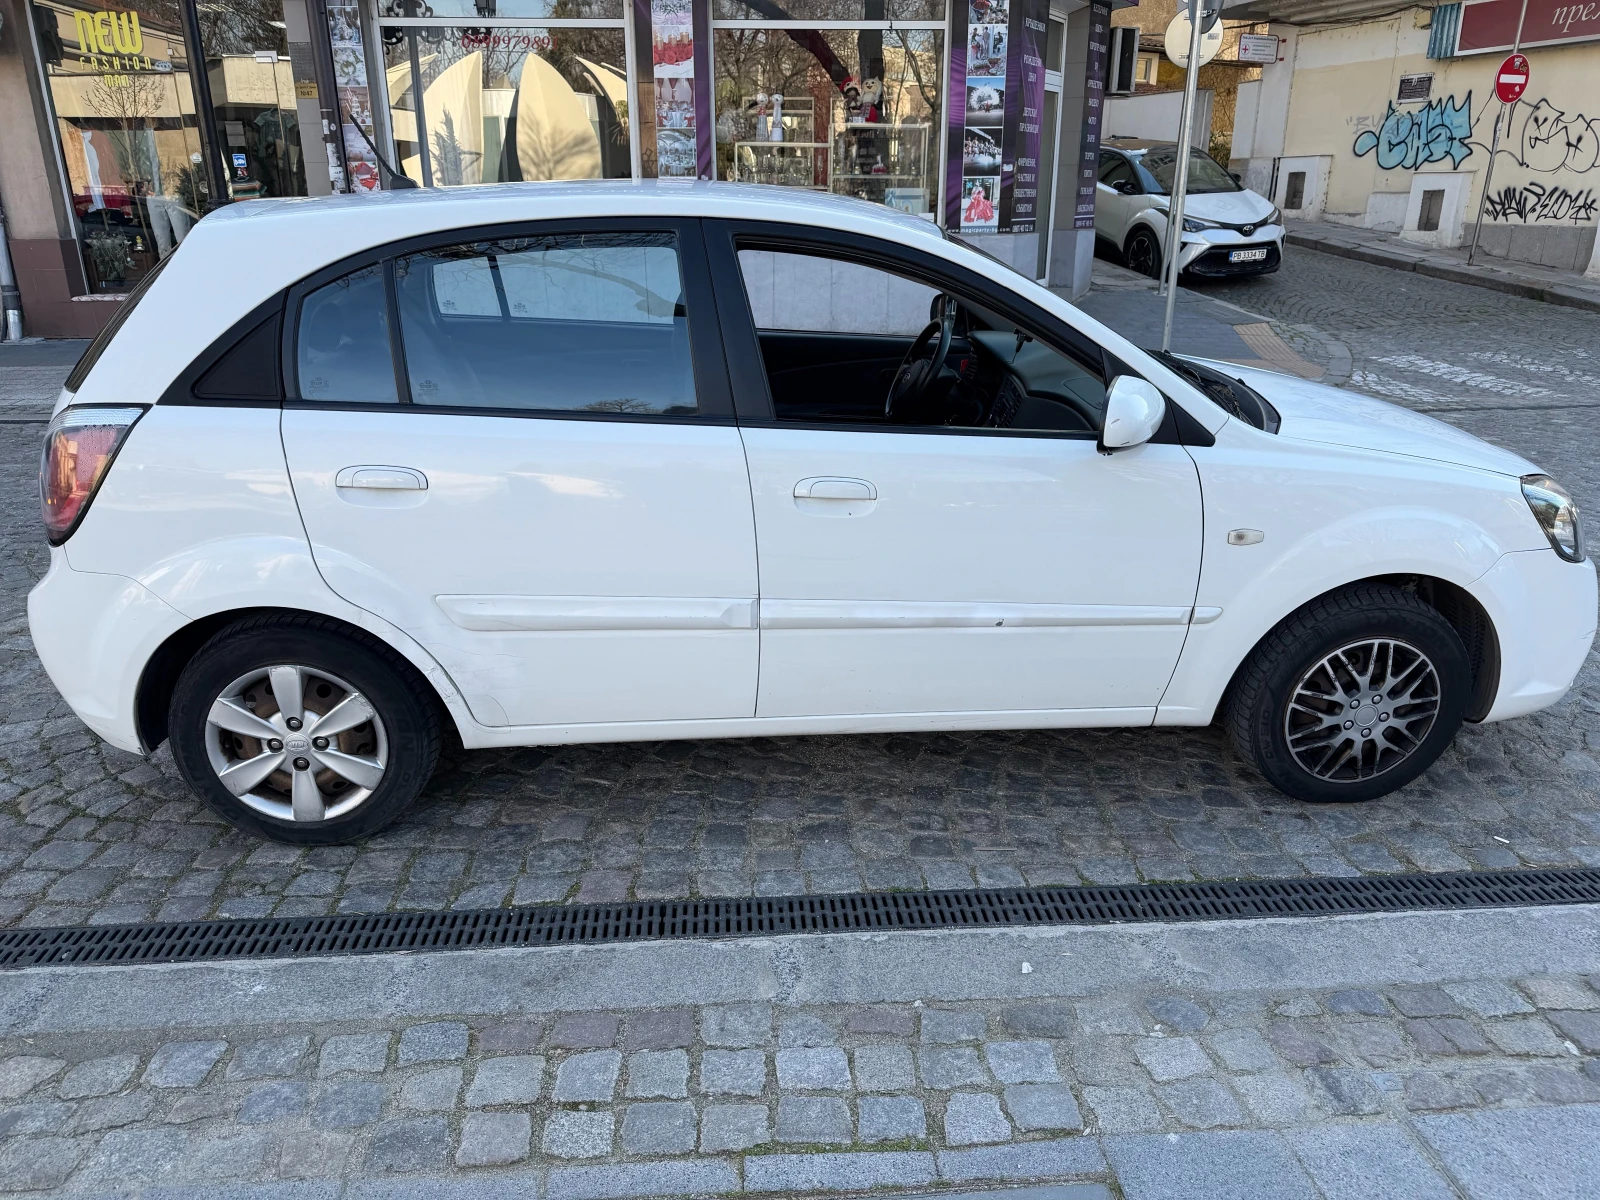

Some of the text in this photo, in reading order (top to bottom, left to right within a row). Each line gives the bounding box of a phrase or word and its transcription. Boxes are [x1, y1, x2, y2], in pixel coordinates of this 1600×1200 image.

[74, 11, 143, 54] NEW
[461, 34, 558, 50] 0899979891
[80, 56, 152, 70] FASHION
